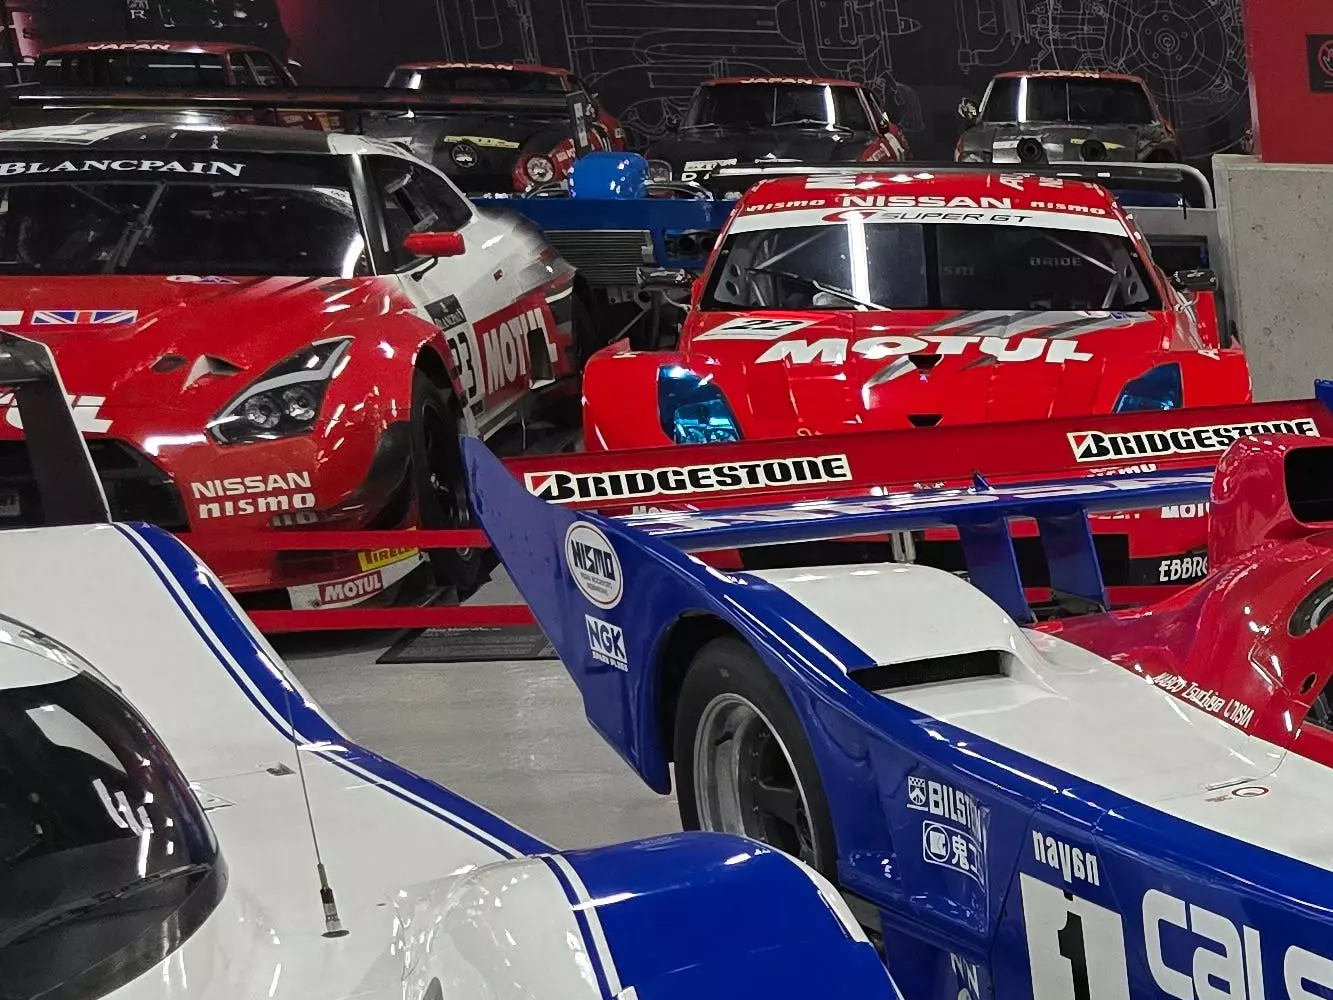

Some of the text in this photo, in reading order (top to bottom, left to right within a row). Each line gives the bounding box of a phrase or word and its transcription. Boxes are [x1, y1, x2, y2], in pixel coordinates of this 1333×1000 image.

[0, 160, 246, 177] BLANCPAIN
[746, 194, 1107, 216] nismo NISSAN nismo
[880, 212, 1032, 224] SUPER GT
[728, 317, 794, 333] 22
[482, 307, 558, 394] MOTL
[755, 335, 1094, 364] MOTUL
[191, 471, 312, 499] NISSAN
[538, 454, 849, 500] BRIDGESTONE
[199, 492, 316, 519] nismo
[570, 540, 616, 581] NISMO
[322, 572, 382, 603] MOTUL
[587, 619, 627, 662] NGK
